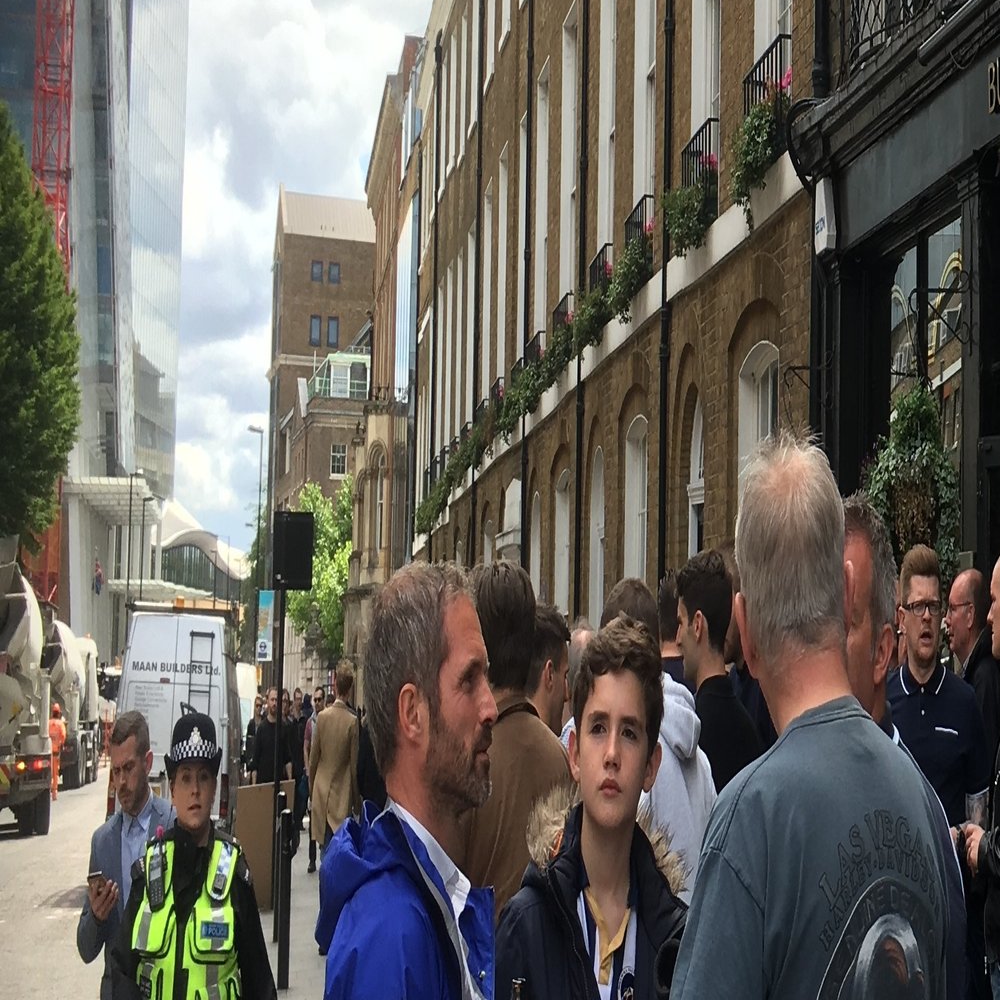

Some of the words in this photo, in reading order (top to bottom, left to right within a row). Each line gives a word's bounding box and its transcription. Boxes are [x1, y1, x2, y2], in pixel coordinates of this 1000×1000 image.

[132, 660, 158, 673] MAAN
[160, 662, 203, 675] BUILDERS
[818, 823, 866, 914] LAS
